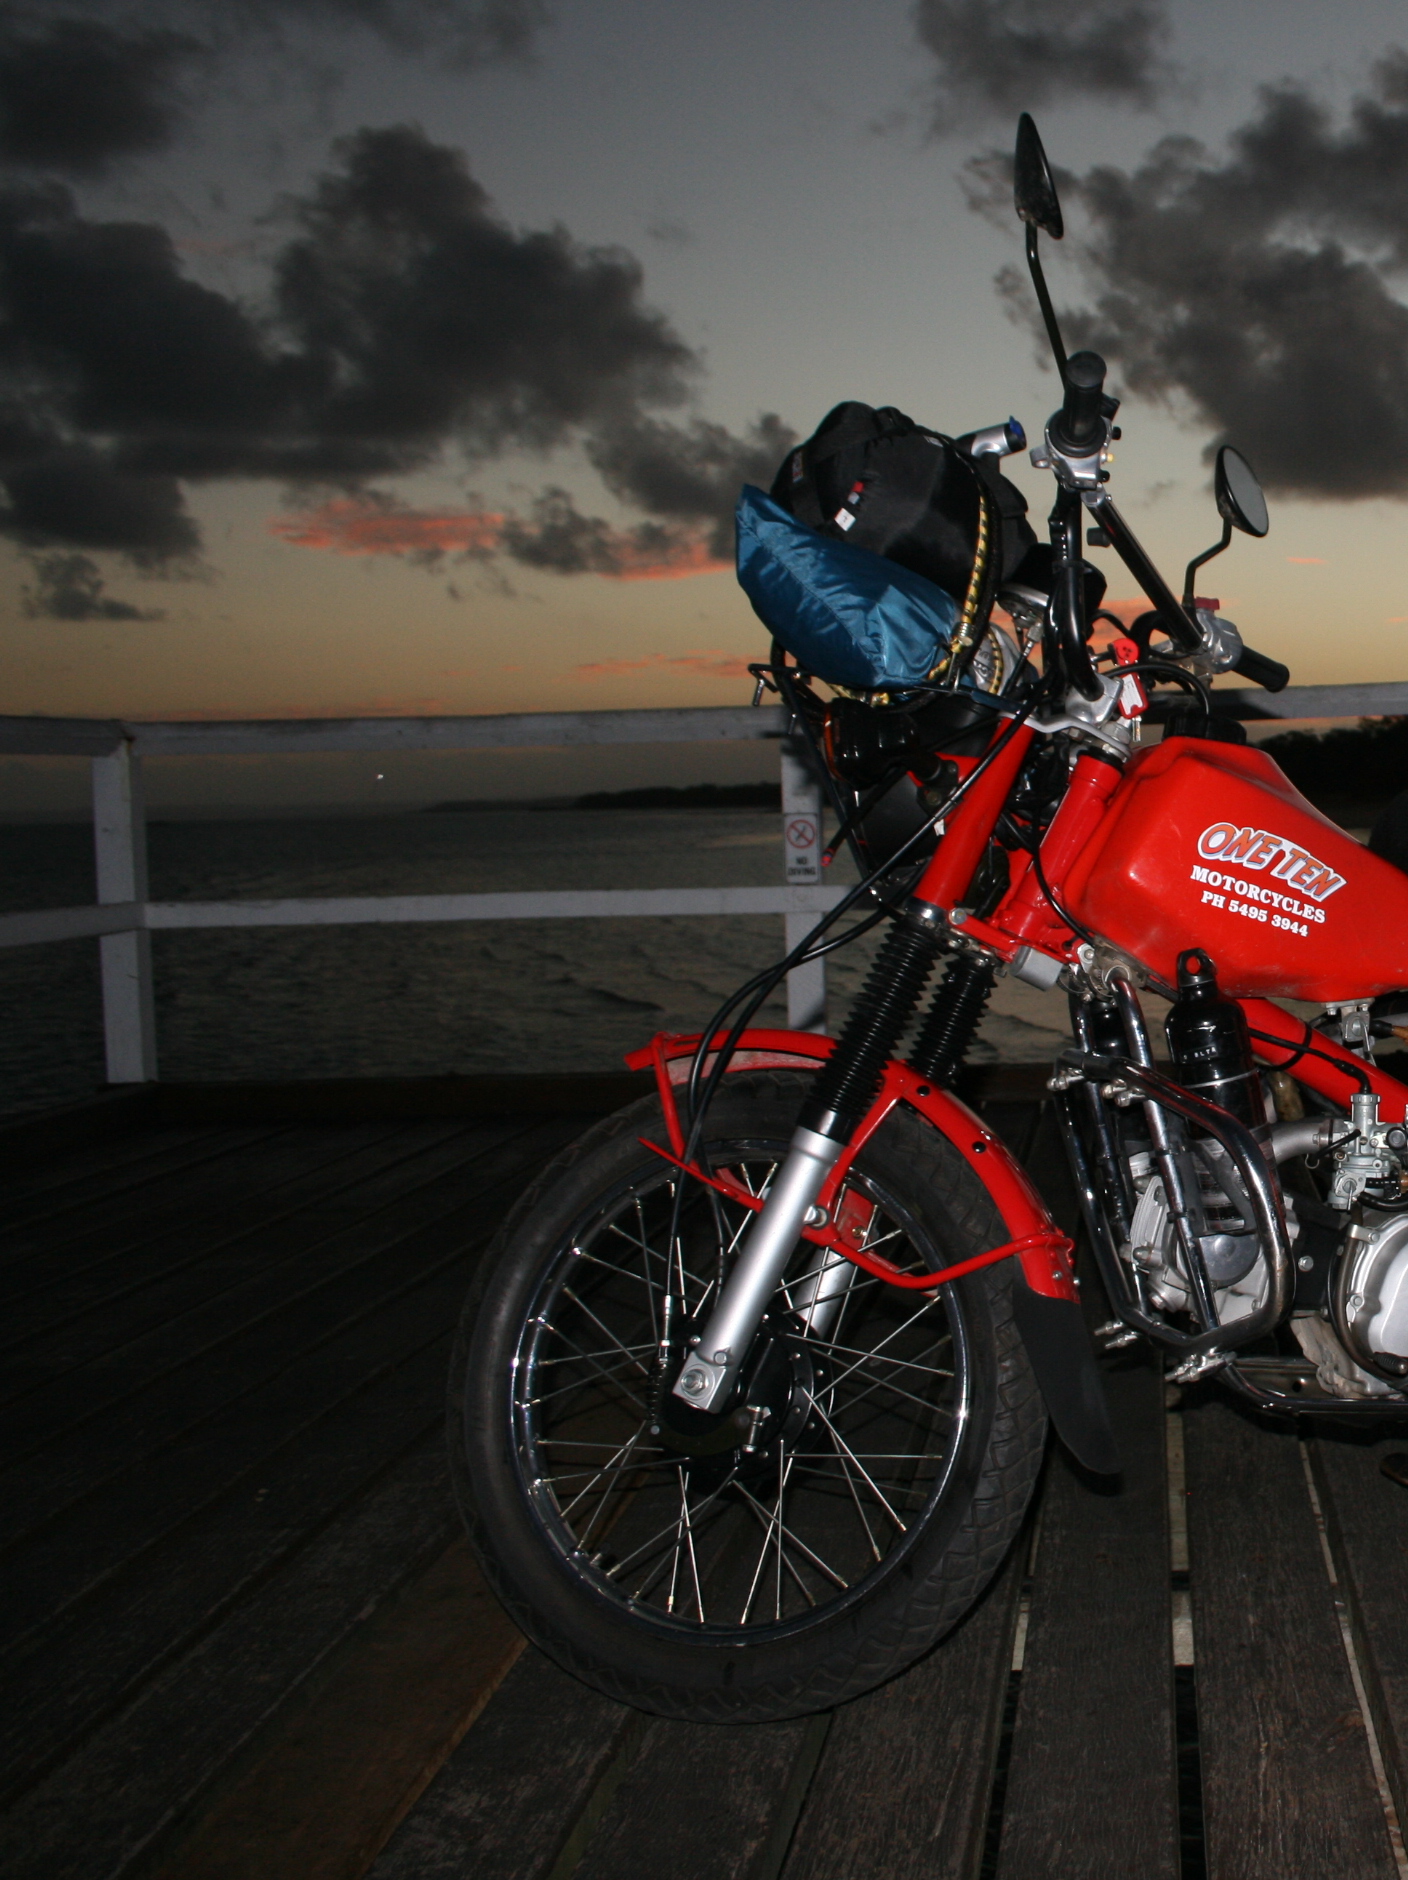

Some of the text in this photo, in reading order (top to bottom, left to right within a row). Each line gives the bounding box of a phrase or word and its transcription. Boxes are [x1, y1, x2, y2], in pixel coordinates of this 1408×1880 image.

[1198, 822, 1346, 902] ONE TEN
[1190, 864, 1327, 924] MOTORCYCLES
[1201, 889, 1309, 937] PH 5495 3944
